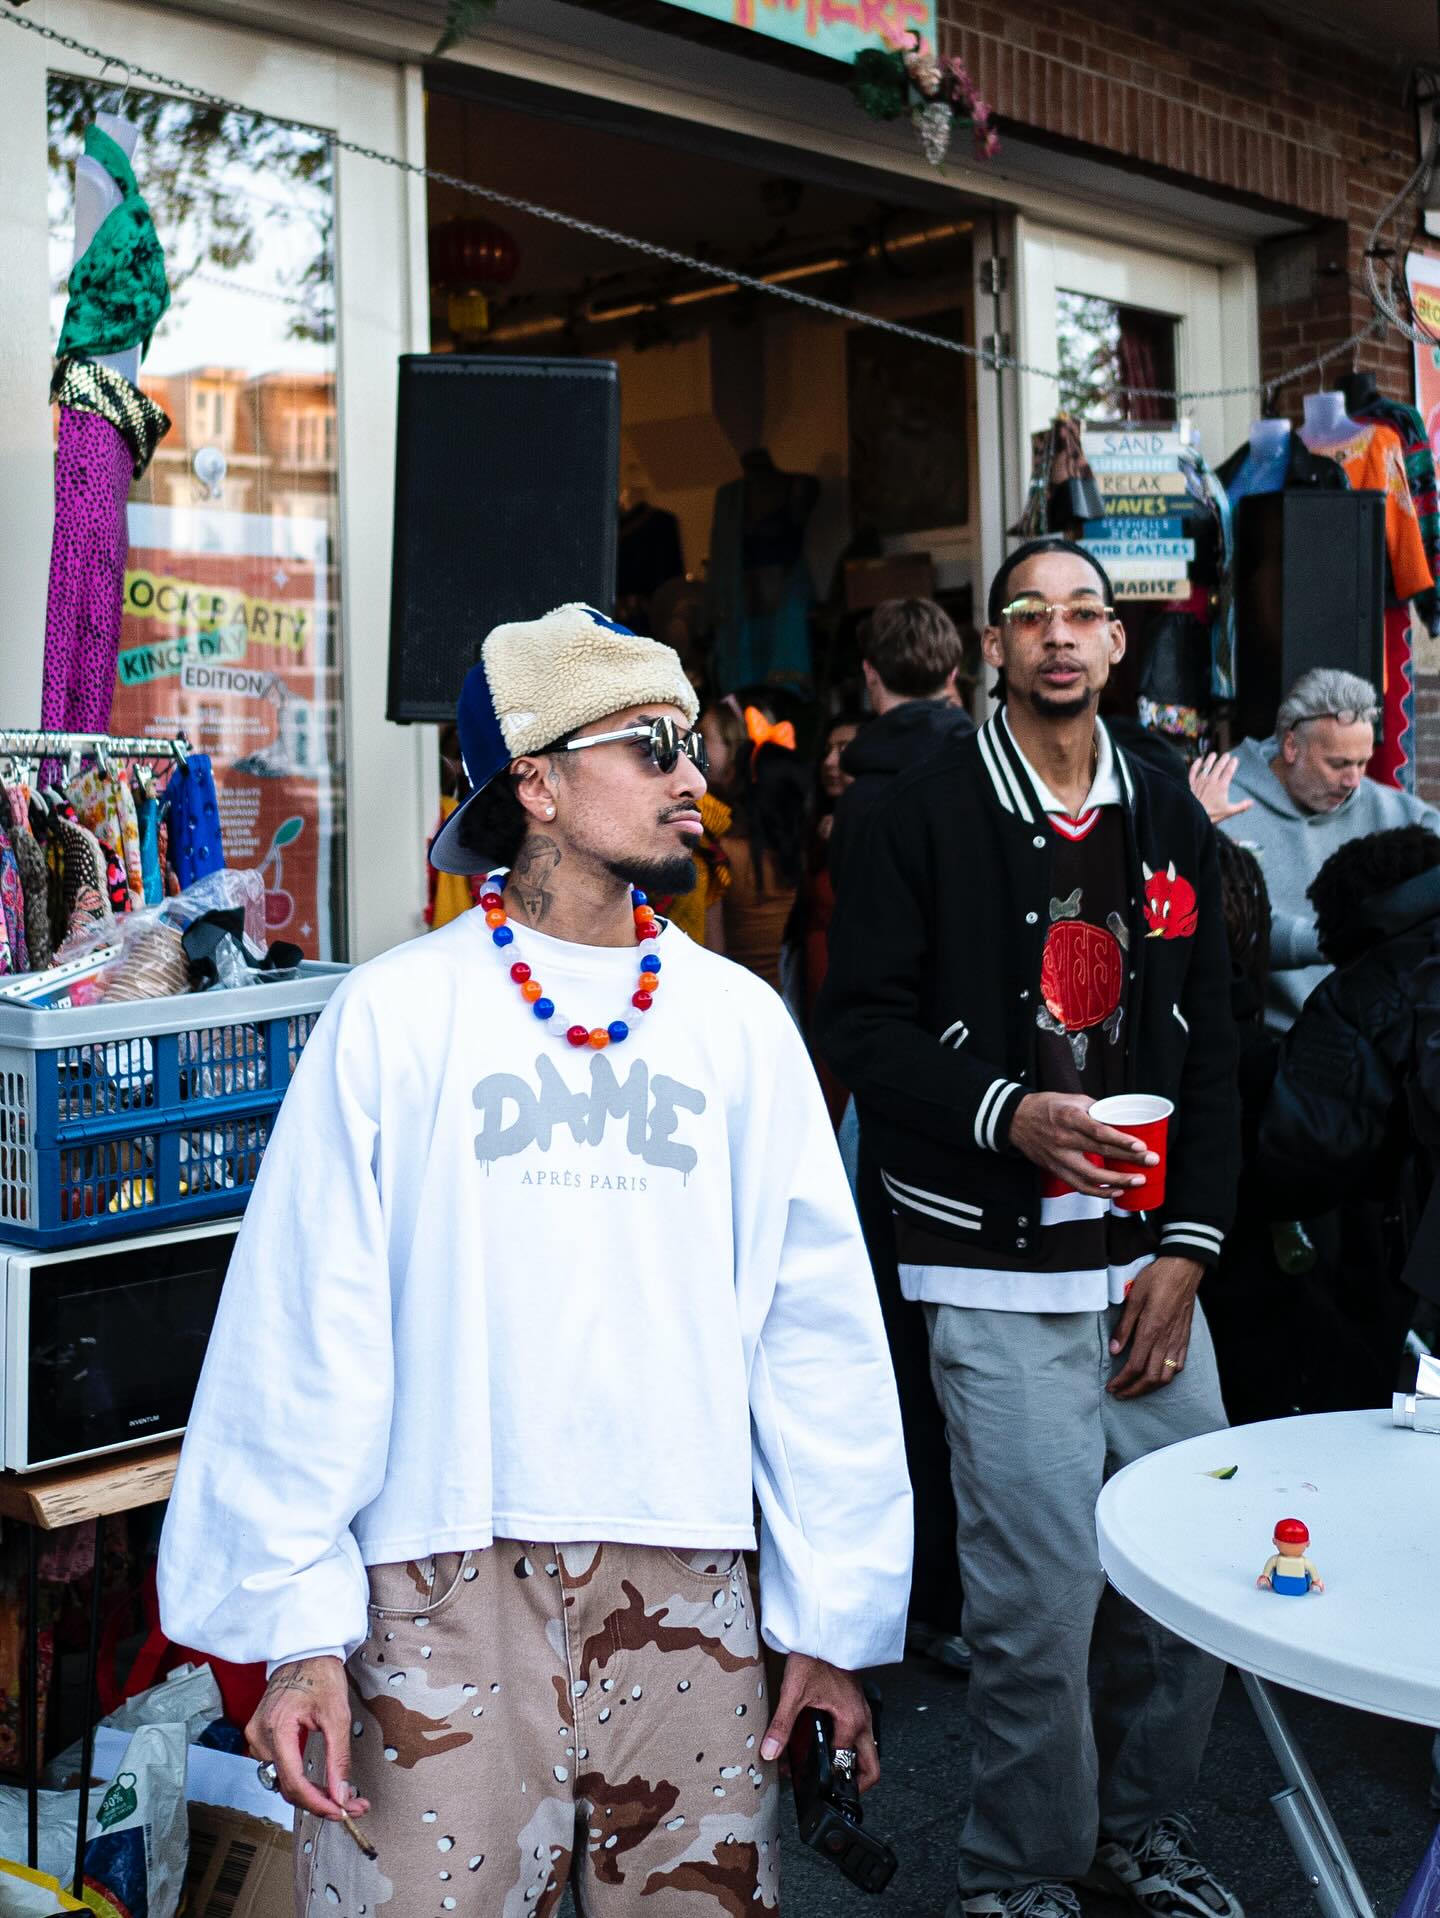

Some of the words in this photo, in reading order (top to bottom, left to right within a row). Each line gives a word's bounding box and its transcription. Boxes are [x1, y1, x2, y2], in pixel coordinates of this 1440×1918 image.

[1104, 434, 1164, 454] SAND
[1104, 475, 1160, 491] RELAX
[1126, 543, 1189, 556] CASTLES
[210, 595, 306, 643] PARTY
[184, 666, 263, 693] EDITION
[472, 1053, 706, 1180] DAME
[590, 1174, 648, 1191] PARIS
[102, 1791, 124, 1811] 90%
